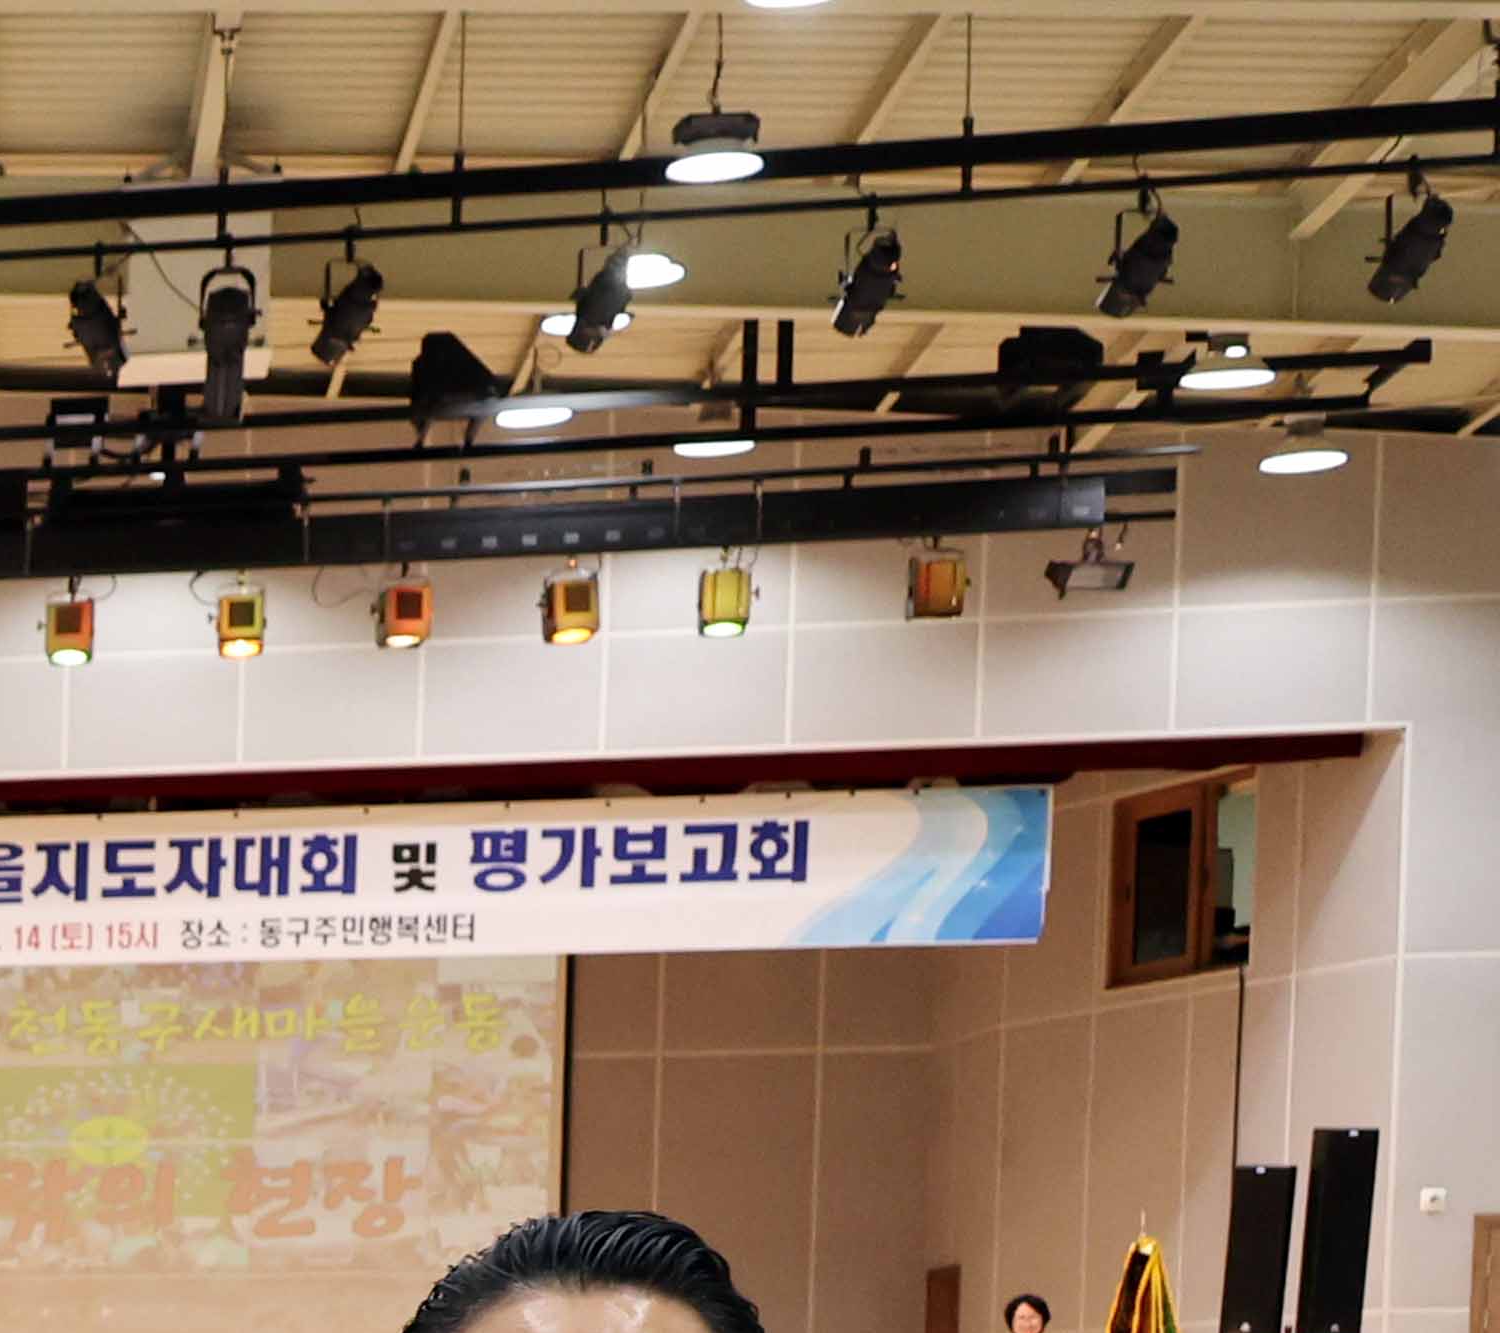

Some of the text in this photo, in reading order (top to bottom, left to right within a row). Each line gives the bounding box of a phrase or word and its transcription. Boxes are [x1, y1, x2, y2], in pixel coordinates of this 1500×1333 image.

[391, 841, 437, 893] 및
[469, 819, 810, 893] 평가보고회
[105, 919, 159, 951] 15시
[180, 918, 232, 949] 장소
[258, 914, 476, 947] 동구주민행복센터
[225, 1146, 424, 1239] 현장
